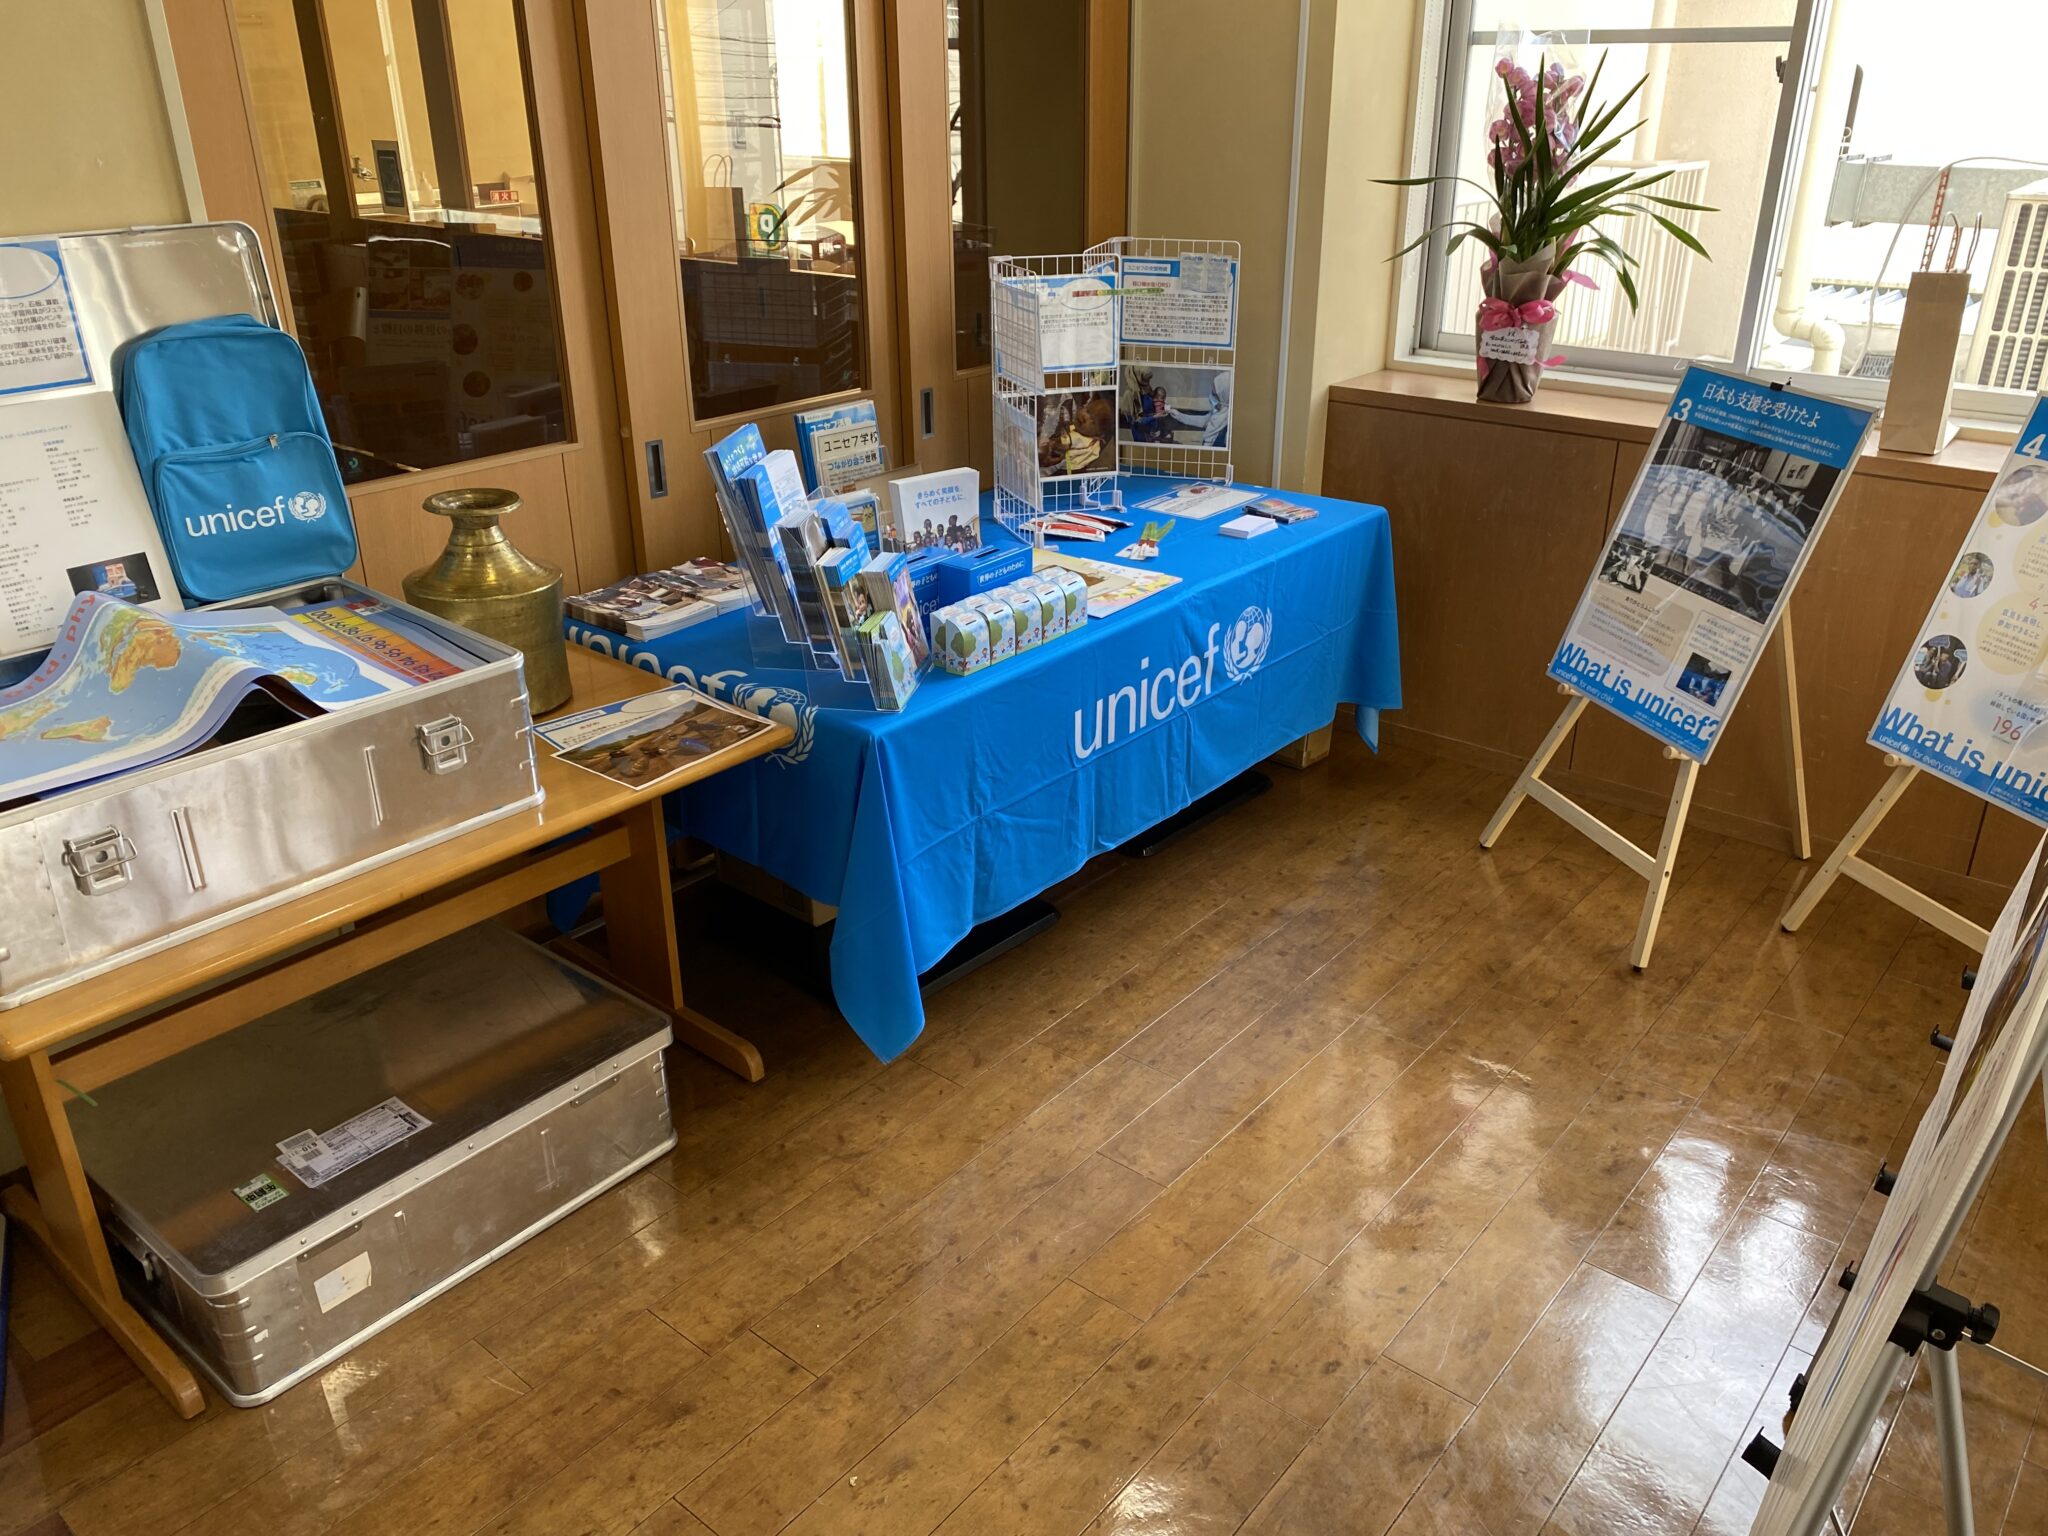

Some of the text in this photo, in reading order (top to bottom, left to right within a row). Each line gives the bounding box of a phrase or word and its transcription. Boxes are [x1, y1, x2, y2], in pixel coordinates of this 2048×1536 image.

[1673, 398, 1693, 421] 3
[1702, 382, 1822, 429] 日本も支援を受けたよ
[2022, 433, 2047, 458] 4
[185, 495, 285, 537] unicef
[310, 609, 336, 623] 100
[1074, 622, 1221, 760] unicef
[1560, 640, 1611, 687] What
[1612, 669, 1633, 701] is
[1635, 687, 1720, 741] unicef?
[1879, 702, 1955, 755] What
[1956, 738, 1986, 771] is
[1992, 715, 2024, 741] 196
